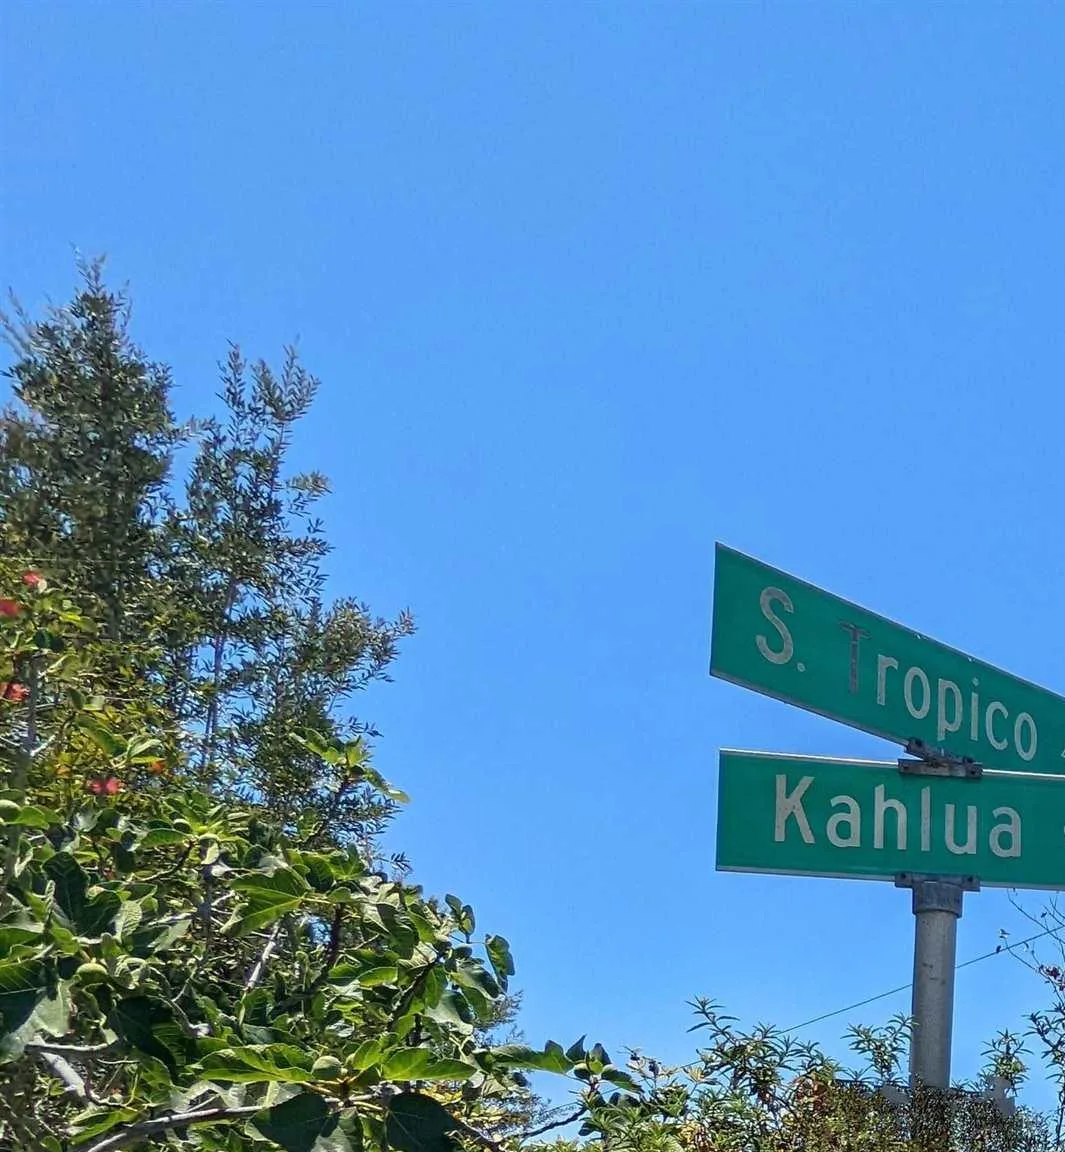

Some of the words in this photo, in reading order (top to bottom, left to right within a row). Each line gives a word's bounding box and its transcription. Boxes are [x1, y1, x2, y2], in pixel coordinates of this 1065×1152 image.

[756, 586, 806, 673] S.
[839, 622, 1039, 762] Tropico
[774, 774, 1022, 859] Kahlua
